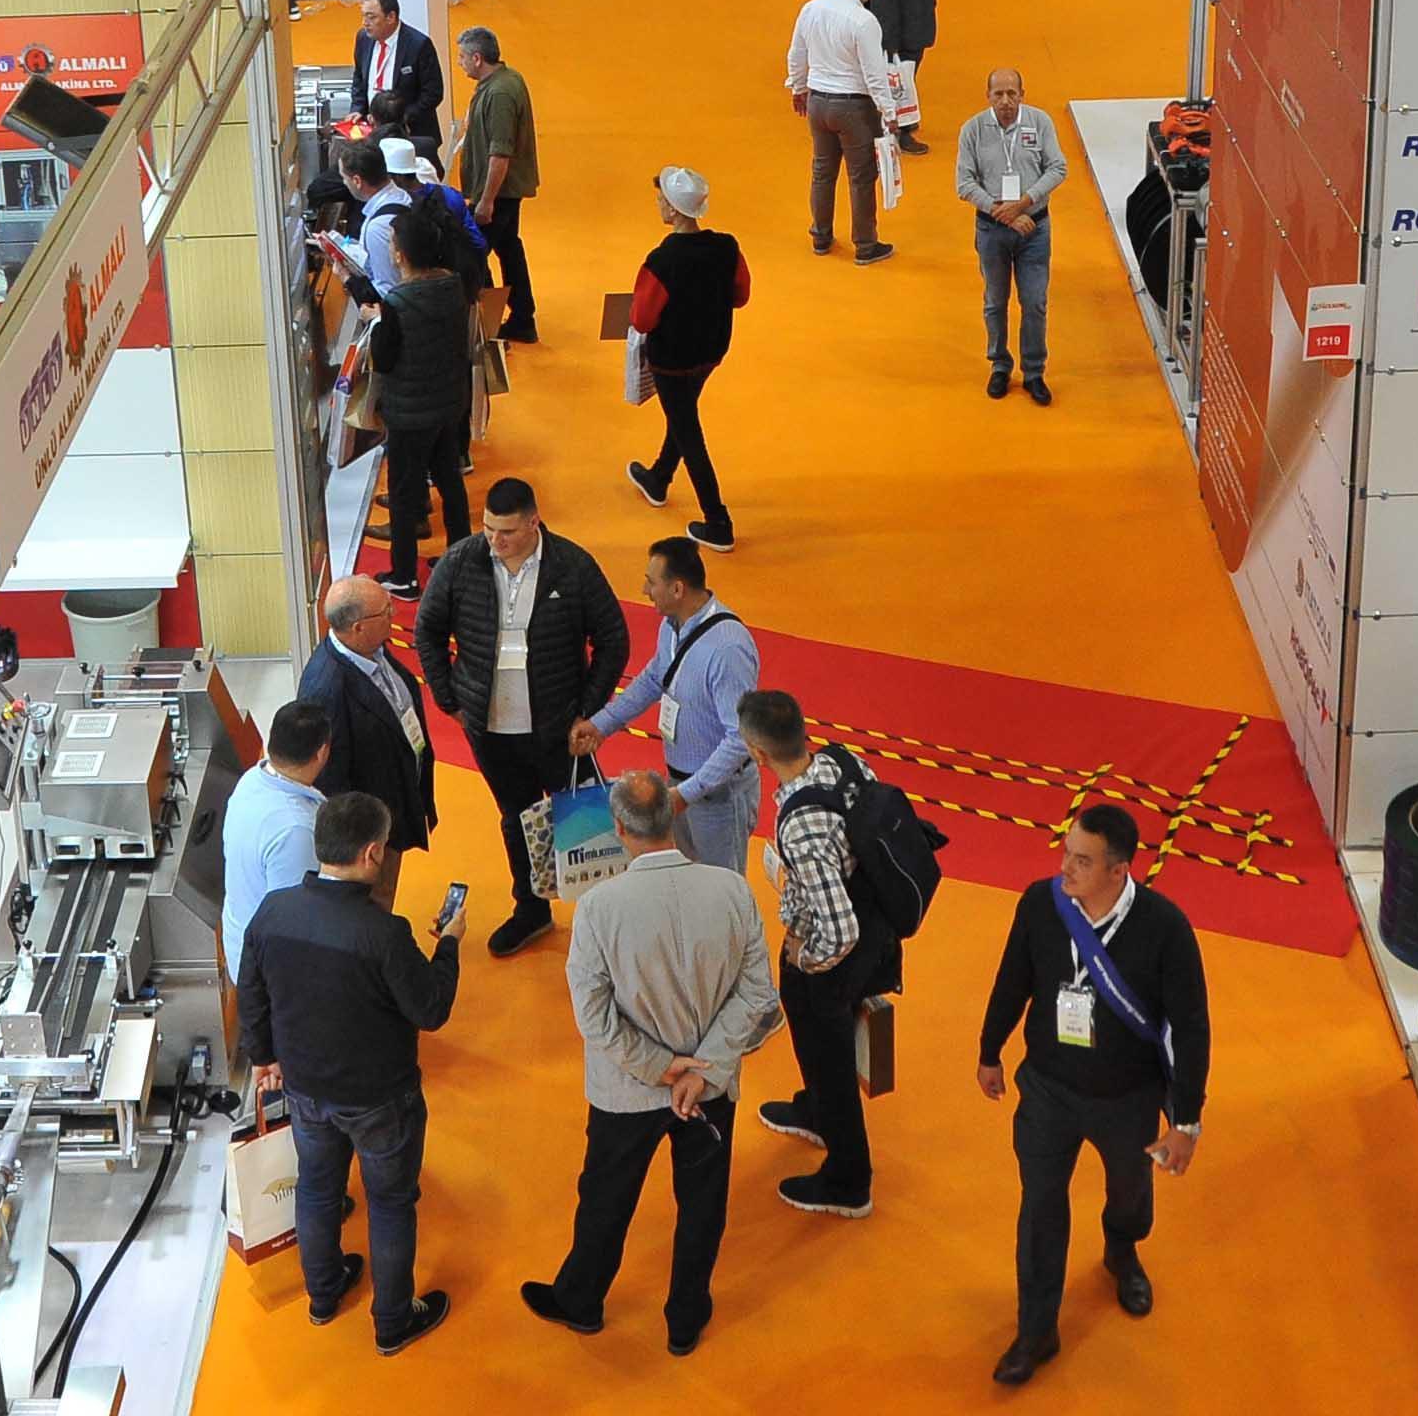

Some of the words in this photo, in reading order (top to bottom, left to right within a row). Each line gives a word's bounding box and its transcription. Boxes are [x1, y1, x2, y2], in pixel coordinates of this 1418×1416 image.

[59, 56, 127, 72] ALMALI
[92, 79, 118, 89] LTD.
[88, 224, 127, 321] ALMALI
[1316, 335, 1342, 347] 1219
[35, 438, 58, 489] ÜNLÜ
[58, 385, 85, 444] ALMALI
